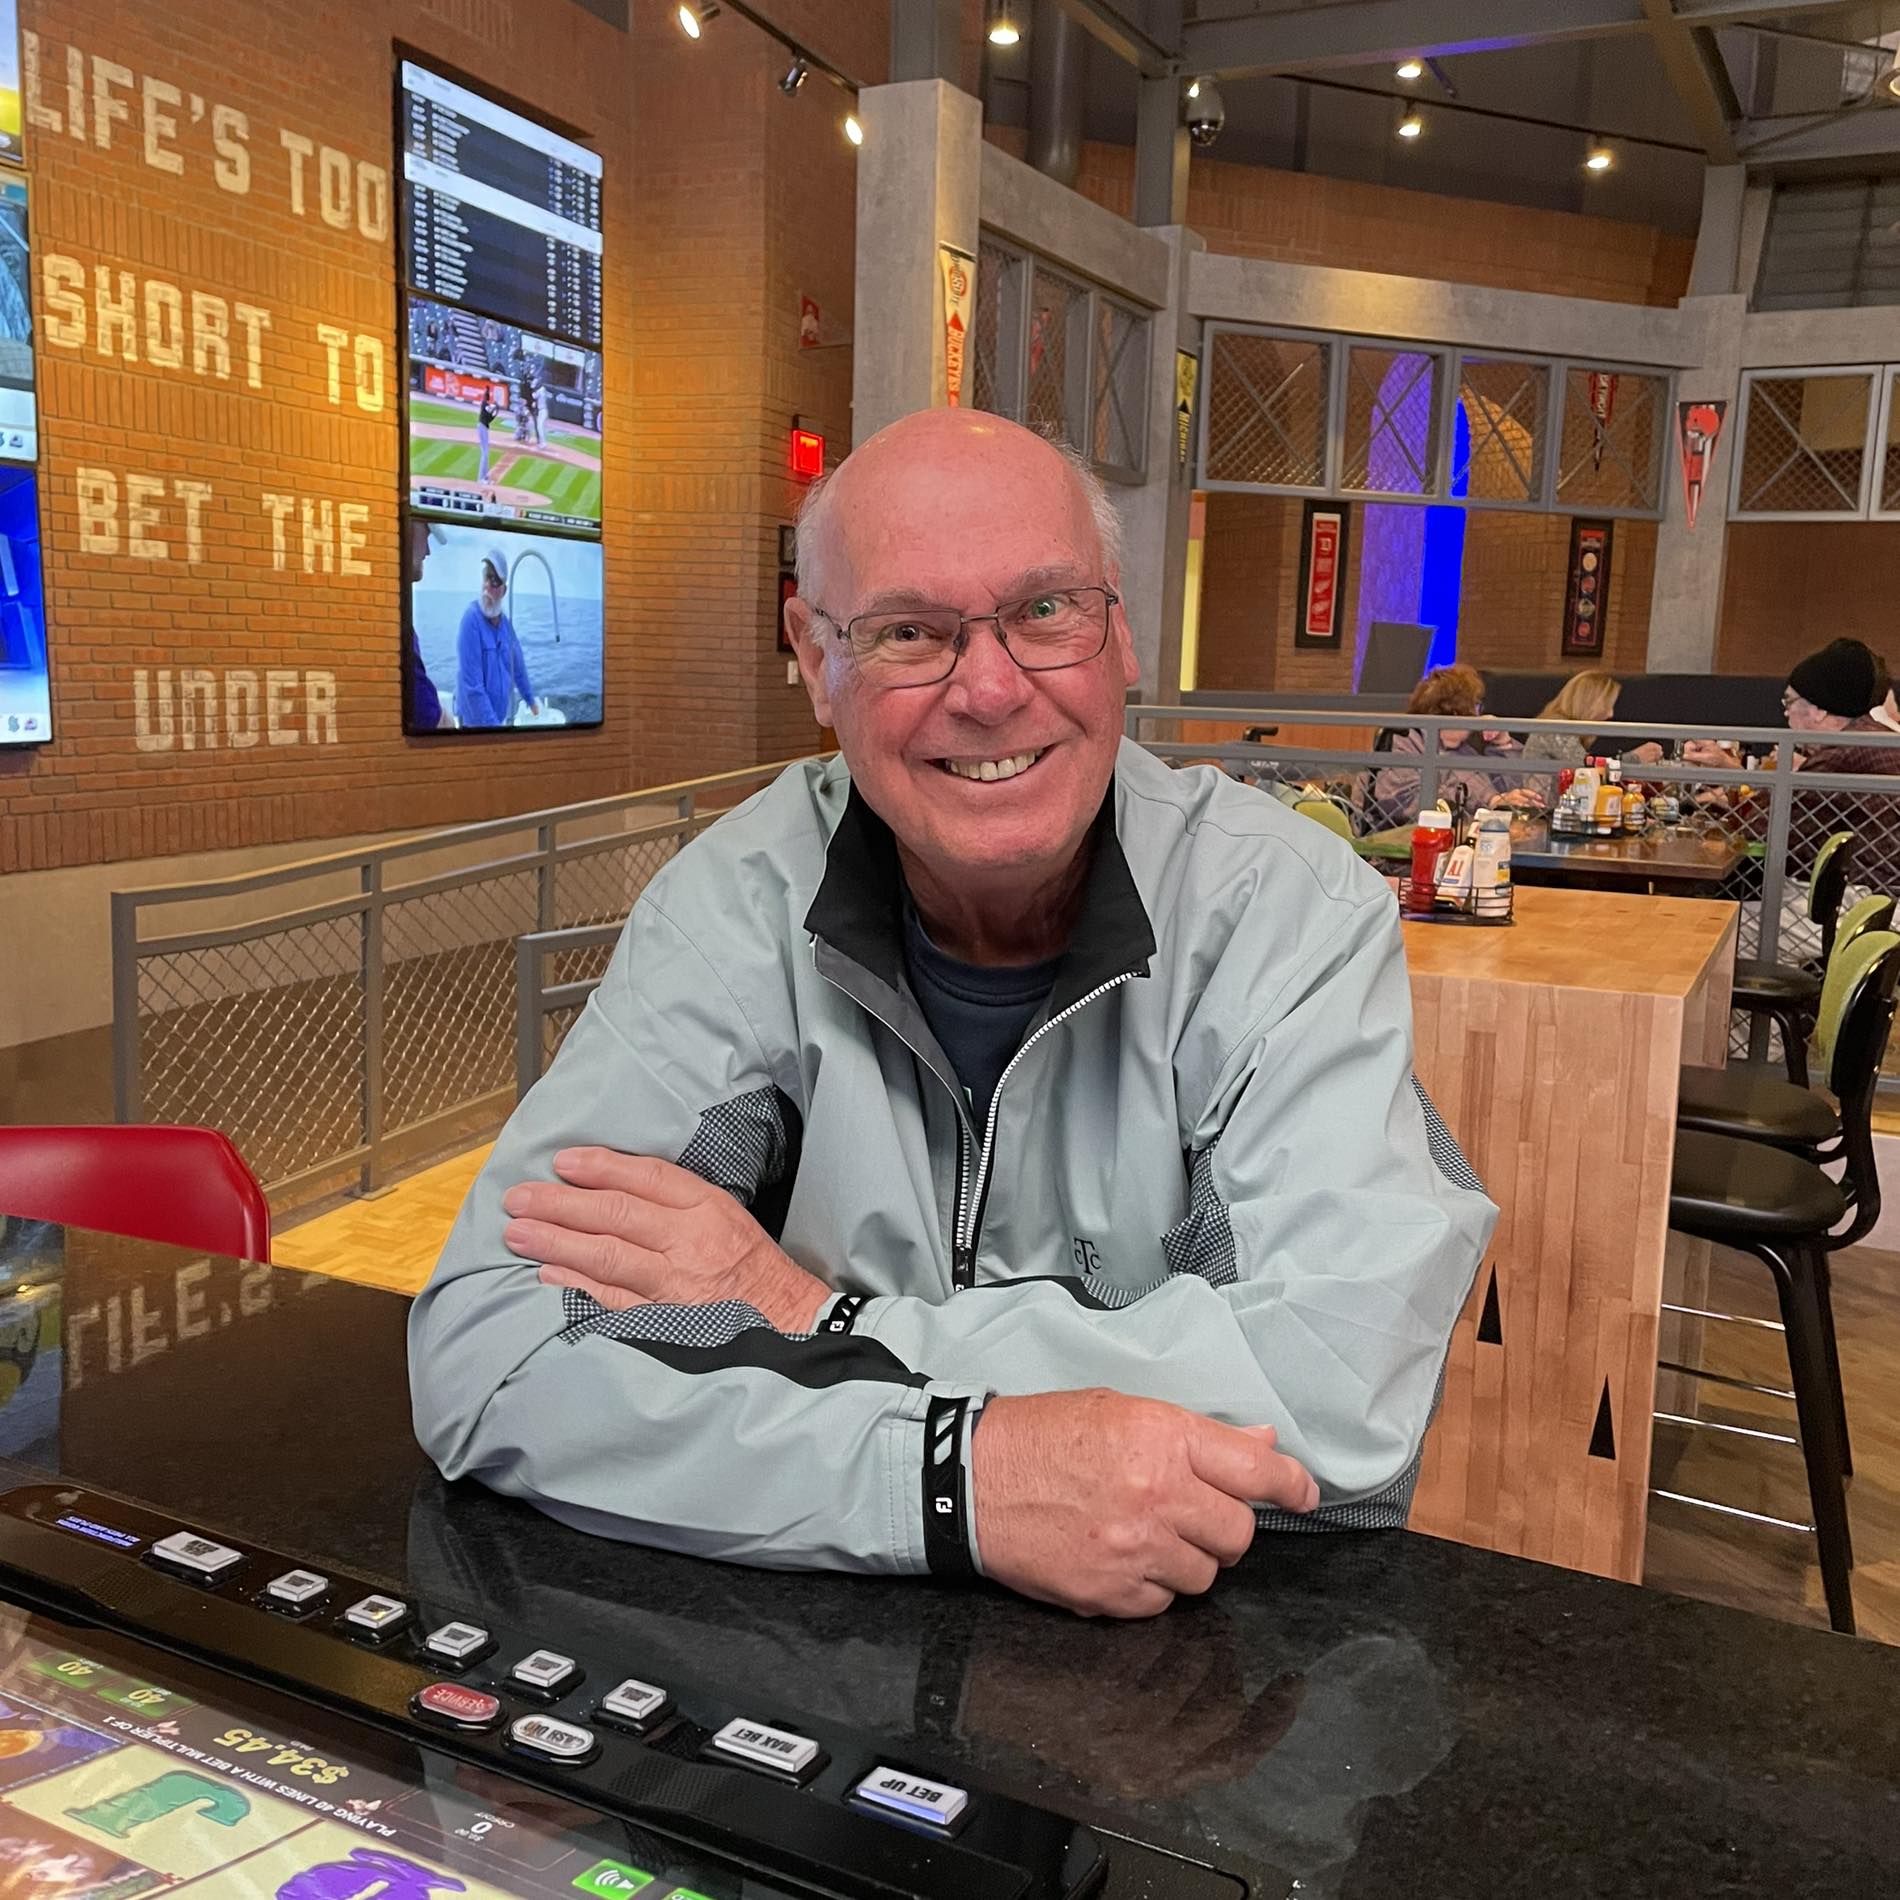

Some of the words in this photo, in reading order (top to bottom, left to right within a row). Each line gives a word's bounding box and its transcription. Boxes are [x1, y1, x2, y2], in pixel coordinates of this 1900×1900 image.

[23, 29, 250, 195] LIFE'S
[279, 128, 387, 242] TOO
[42, 253, 273, 389] SHORT
[316, 322, 384, 412] TO
[76, 466, 213, 564] BET
[261, 492, 372, 576] THE
[133, 669, 338, 751] UNDER
[57, 1661, 93, 1676] 40
[128, 1689, 165, 1704] 40
[433, 1688, 486, 1714] SERVICE
[113, 1719, 133, 1732] OF
[128, 1725, 204, 1760] MULTIPLIER
[731, 1728, 765, 1745] BET
[759, 1735, 798, 1754] MAX
[199, 1755, 232, 1773] BET
[212, 1727, 350, 1786] $34.45
[238, 1769, 277, 1790] WITH
[879, 1778, 907, 1794] UP
[276, 1785, 317, 1805] LINES
[906, 1785, 943, 1803] BET
[316, 1799, 334, 1812] 40
[334, 1807, 397, 1837] PLAYING
[471, 1821, 493, 1834] 0
